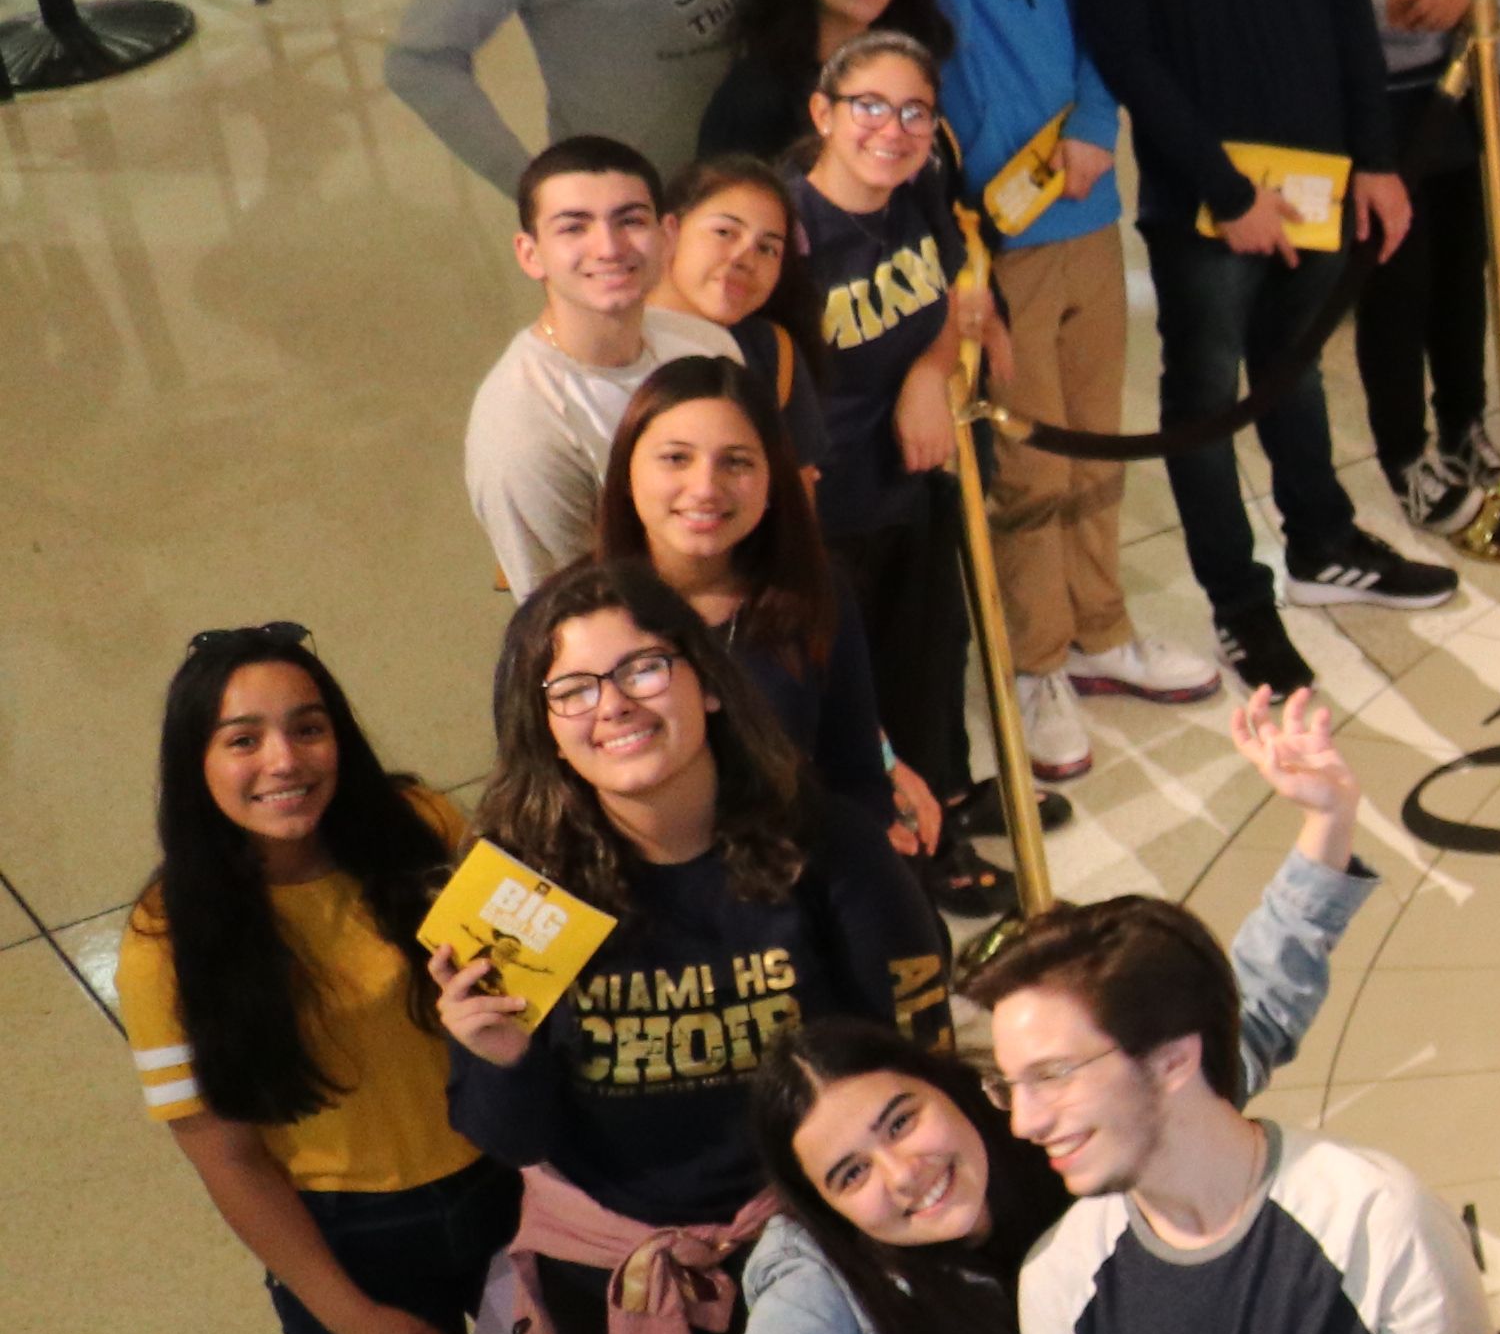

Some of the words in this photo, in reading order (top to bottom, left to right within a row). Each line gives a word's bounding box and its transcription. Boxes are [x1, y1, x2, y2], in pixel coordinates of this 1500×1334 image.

[822, 235, 948, 350] MIAM
[490, 877, 568, 937] BIG
[573, 965, 716, 1010] MIAMI
[733, 947, 797, 999] HS
